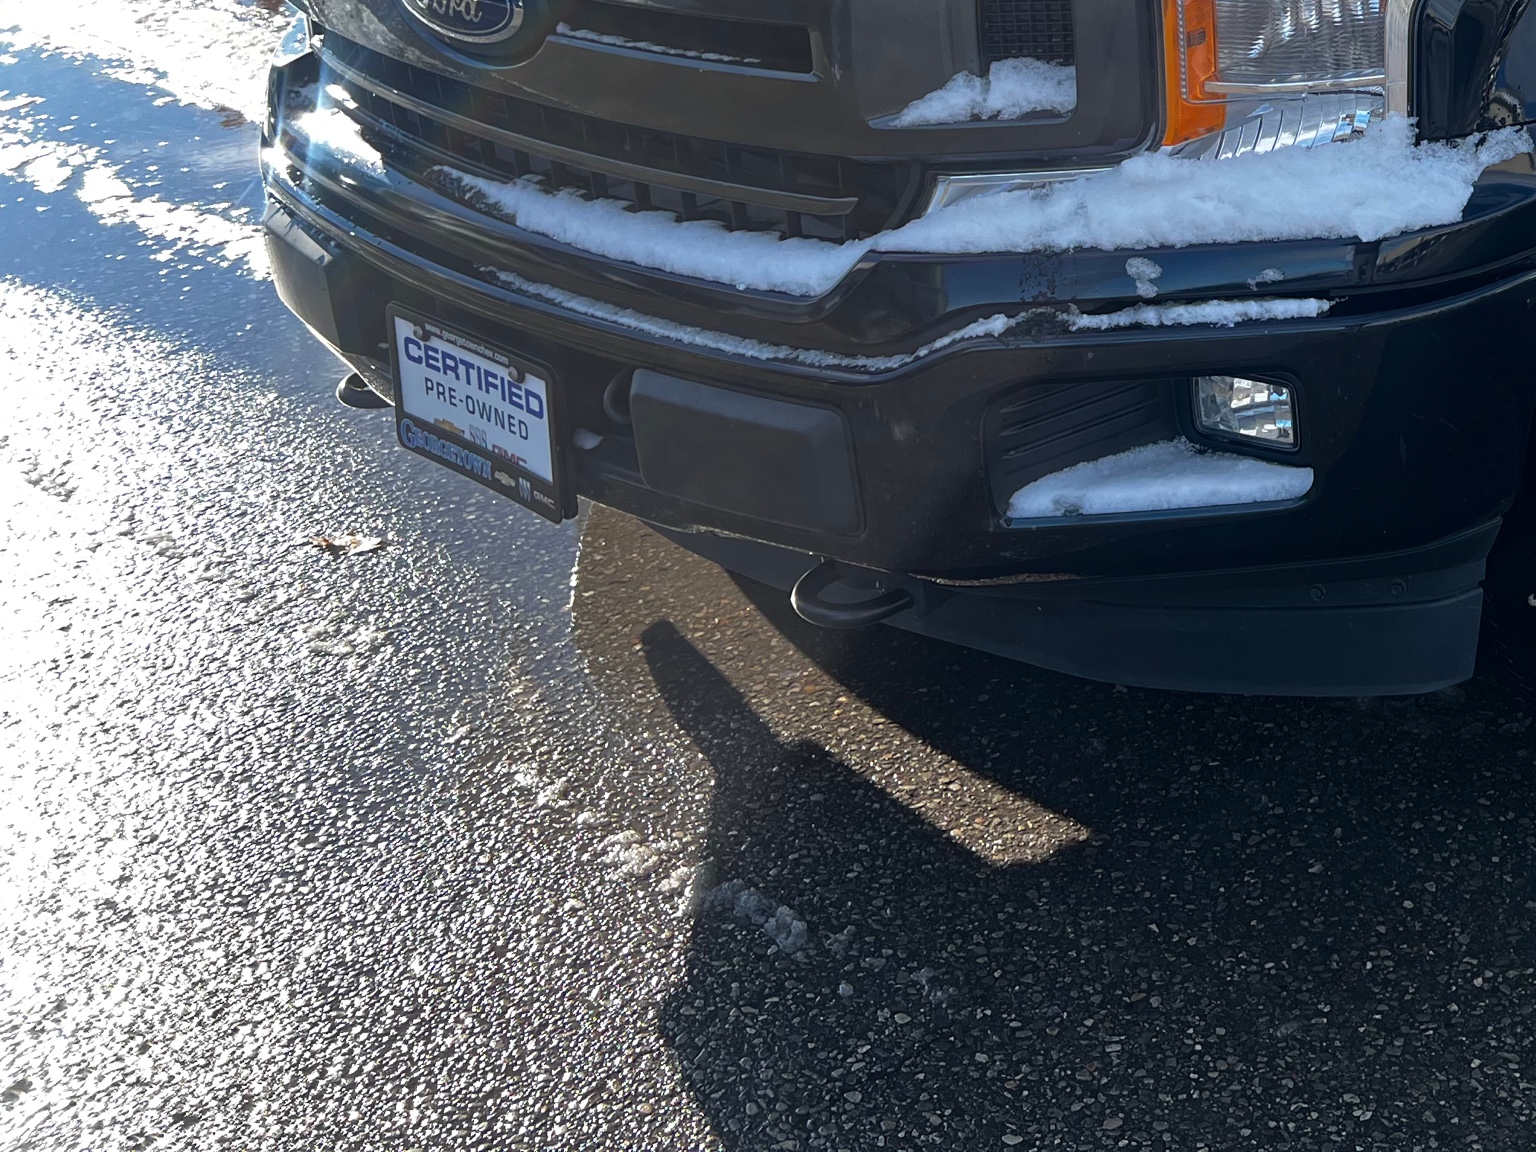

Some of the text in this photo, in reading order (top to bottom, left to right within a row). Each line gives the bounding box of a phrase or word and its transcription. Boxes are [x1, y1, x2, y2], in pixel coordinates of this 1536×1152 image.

[403, 336, 545, 420] CERTIFIED
[424, 376, 530, 441] PRE-OWNED
[400, 418, 493, 481] GEORGETOWN
